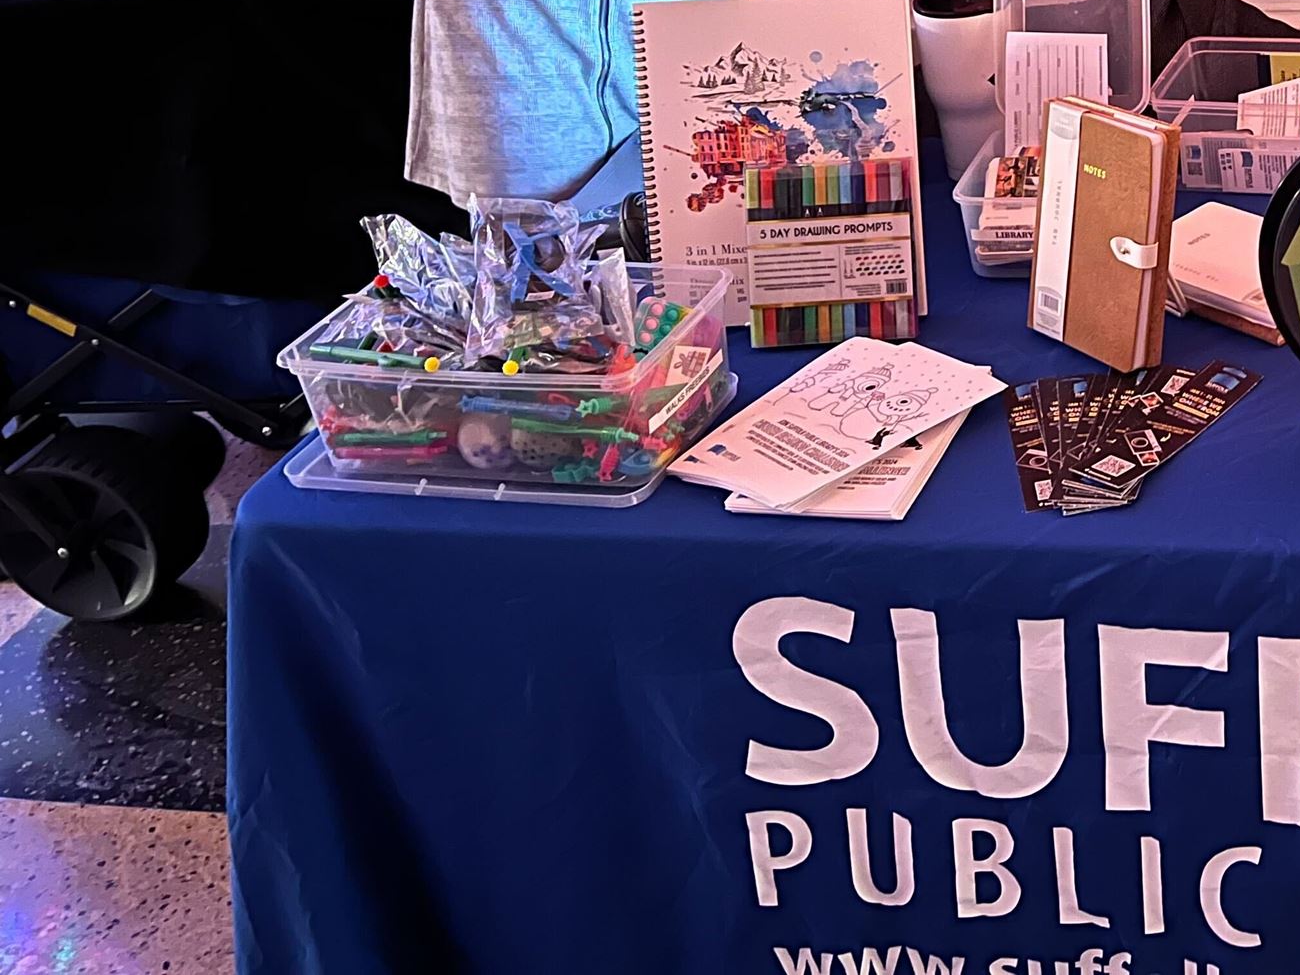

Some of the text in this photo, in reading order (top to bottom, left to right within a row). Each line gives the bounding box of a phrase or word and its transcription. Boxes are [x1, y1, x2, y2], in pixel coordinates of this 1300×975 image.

[1084, 163, 1107, 180] NOTES
[759, 222, 894, 240] 5 DAY DRAWING PROMPTS
[995, 230, 1034, 240] LIBRARY
[686, 242, 749, 257] 3 in 1 Mixe
[665, 392, 686, 415] WALKS
[1209, 400, 1223, 411] WE
[744, 806, 1263, 950] PUBLIC
